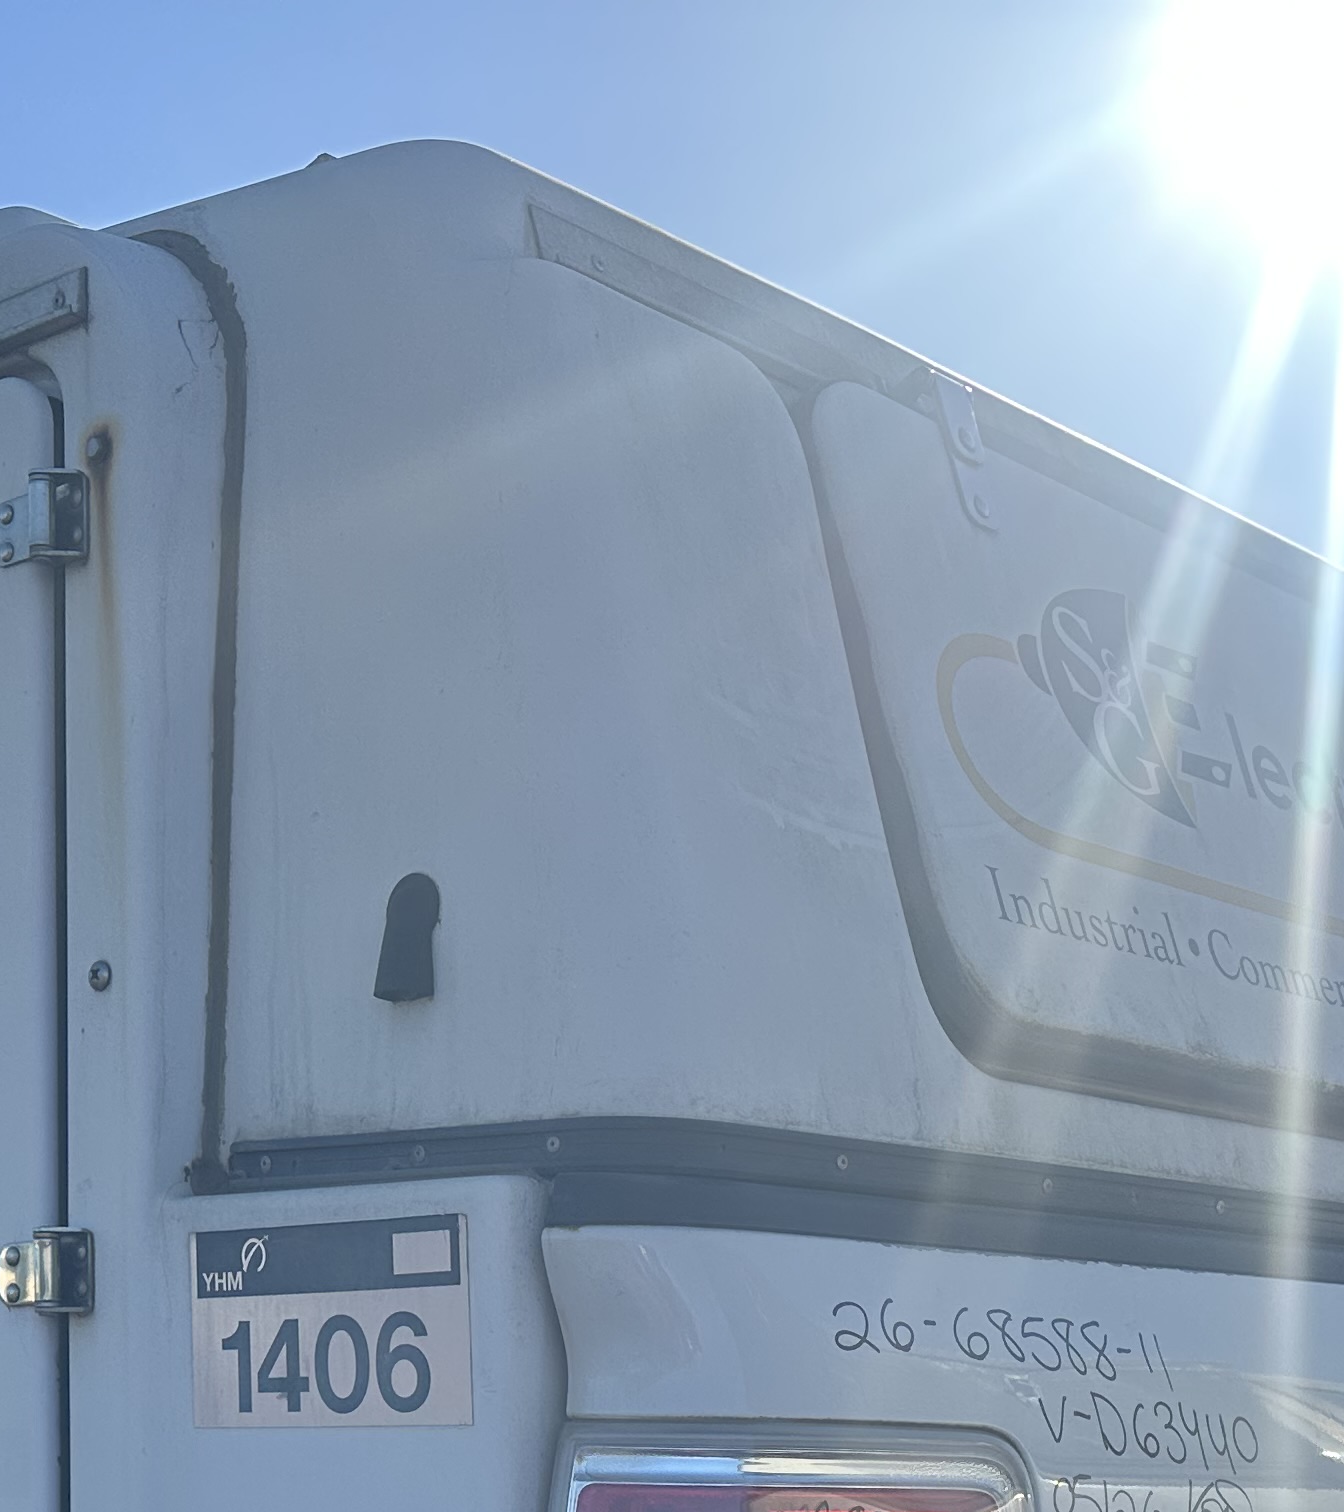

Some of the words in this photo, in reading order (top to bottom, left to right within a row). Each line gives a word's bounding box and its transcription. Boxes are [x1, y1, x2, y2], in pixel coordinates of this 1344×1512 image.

[985, 865, 1186, 968] Industrial
[202, 1271, 243, 1292] YHM
[221, 1311, 432, 1414] 1406
